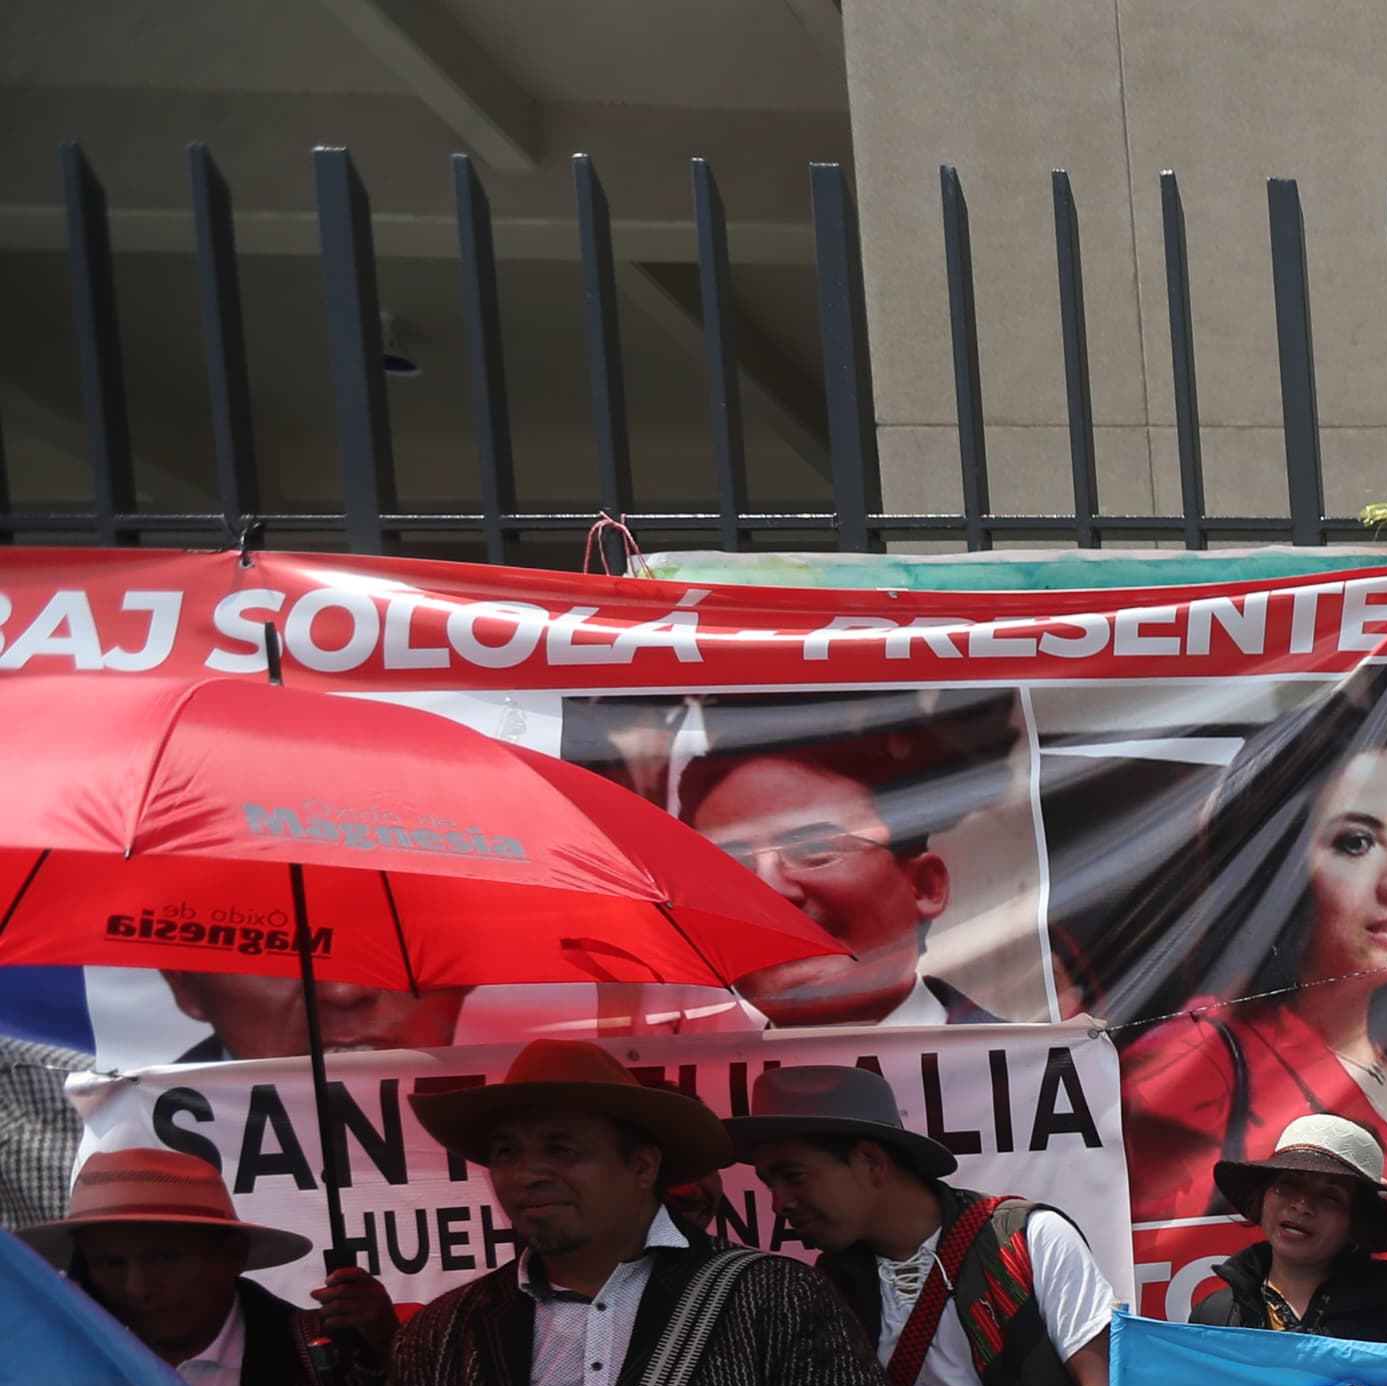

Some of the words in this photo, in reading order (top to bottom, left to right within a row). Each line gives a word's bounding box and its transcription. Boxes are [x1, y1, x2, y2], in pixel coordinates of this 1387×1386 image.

[0, 589, 184, 672] AJ
[204, 589, 704, 673] SOLOLÁ
[243, 802, 528, 858] Magnesia
